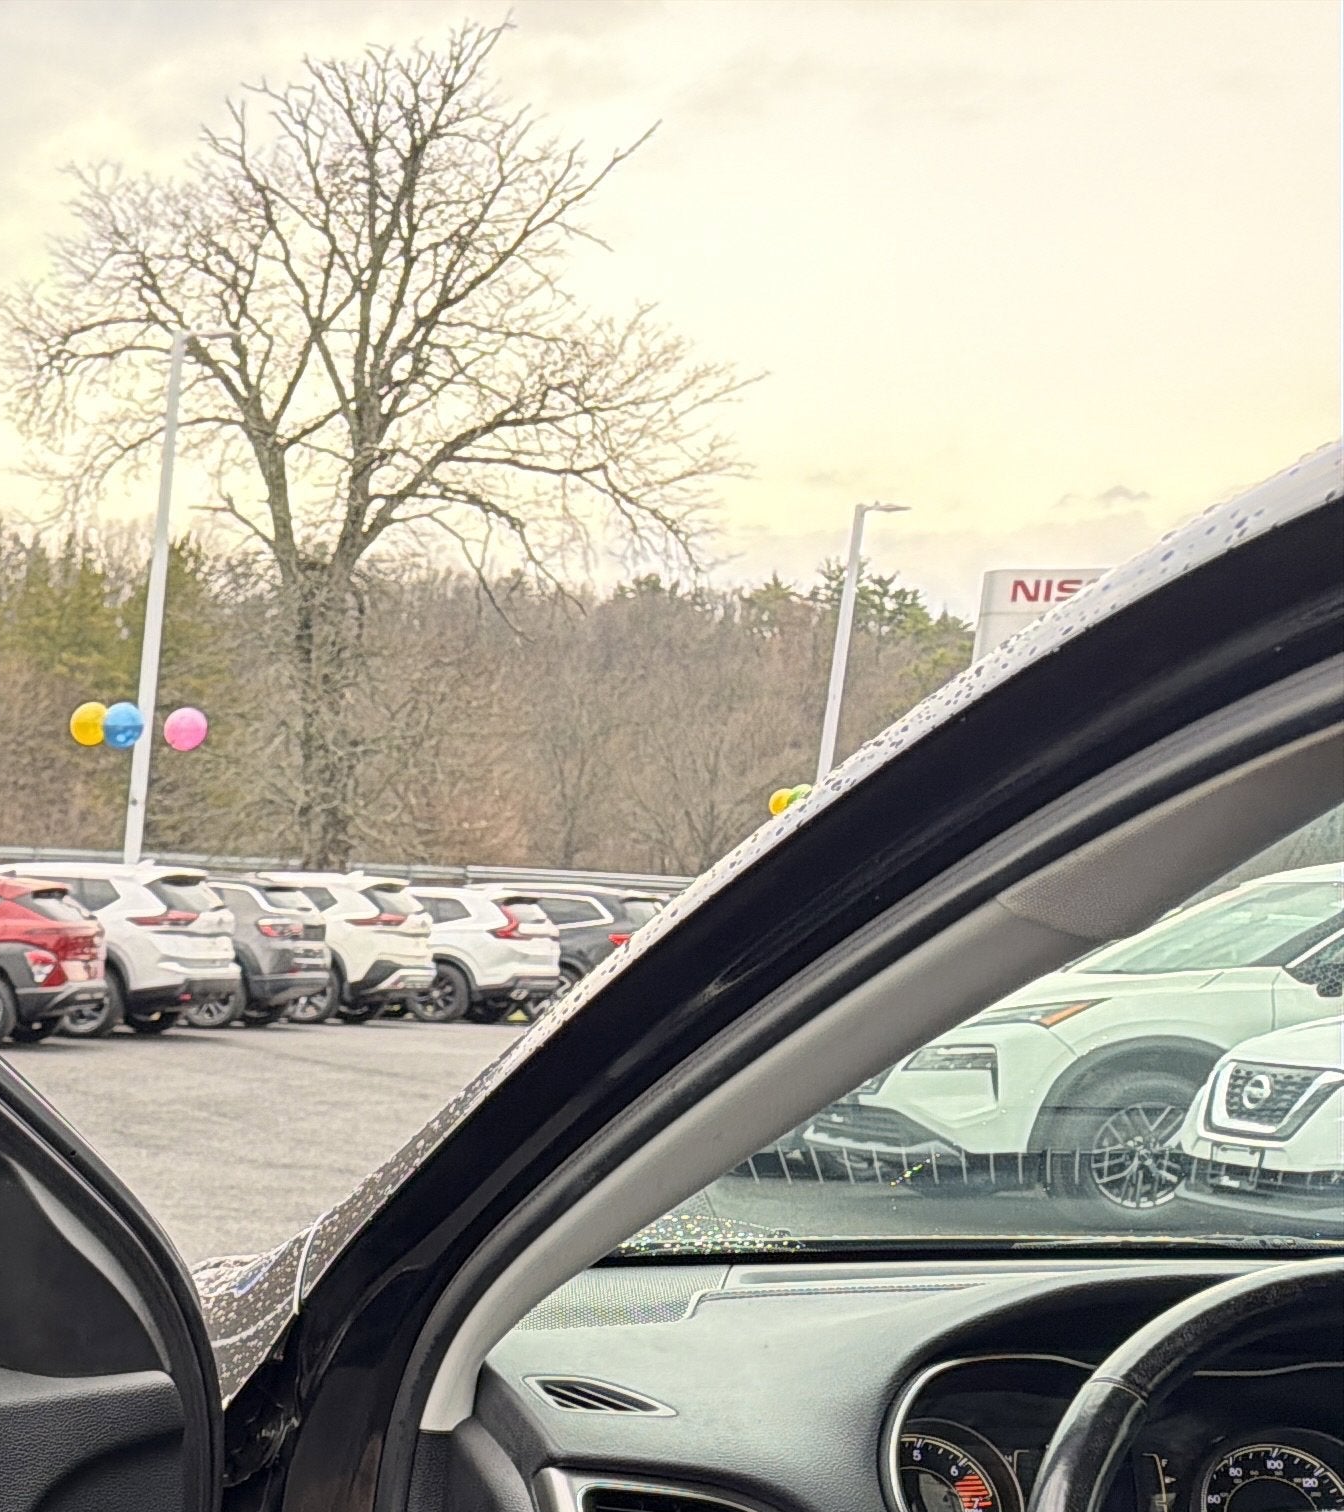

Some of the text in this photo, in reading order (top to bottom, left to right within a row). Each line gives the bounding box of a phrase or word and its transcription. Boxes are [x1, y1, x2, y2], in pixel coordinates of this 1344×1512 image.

[1011, 579, 1099, 602] NIS
[912, 1450, 921, 1460] 5
[1266, 1460, 1283, 1469] 100
[950, 1466, 958, 1476] 6
[1229, 1467, 1242, 1477] 80
[1302, 1478, 1318, 1487] 120
[1207, 1495, 1220, 1504] 60
